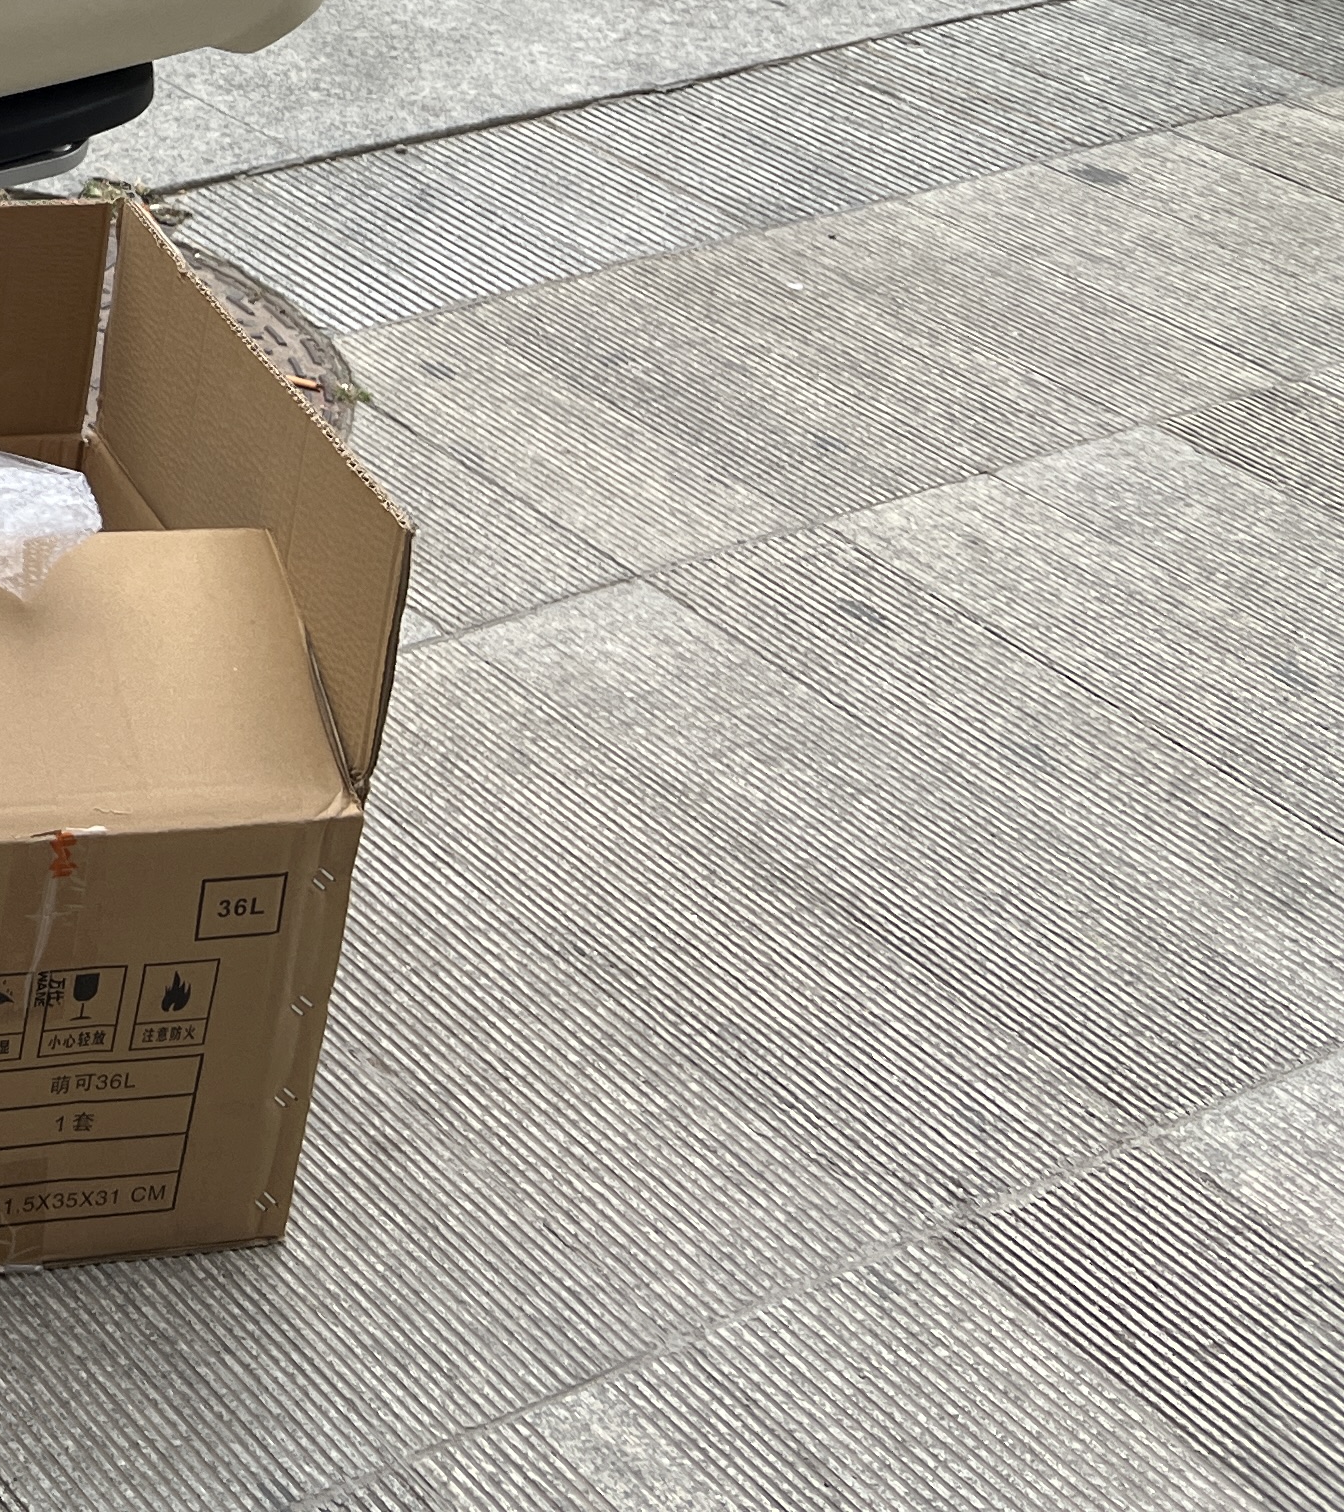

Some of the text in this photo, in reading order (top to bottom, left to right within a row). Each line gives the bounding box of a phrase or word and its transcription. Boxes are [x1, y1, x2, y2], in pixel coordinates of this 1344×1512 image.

[217, 896, 265, 918] 36L
[48, 1029, 107, 1050] 小心轻放
[141, 1024, 196, 1044] 注意防火
[50, 1072, 136, 1095] 萌可36L
[130, 1185, 166, 1203] CM
